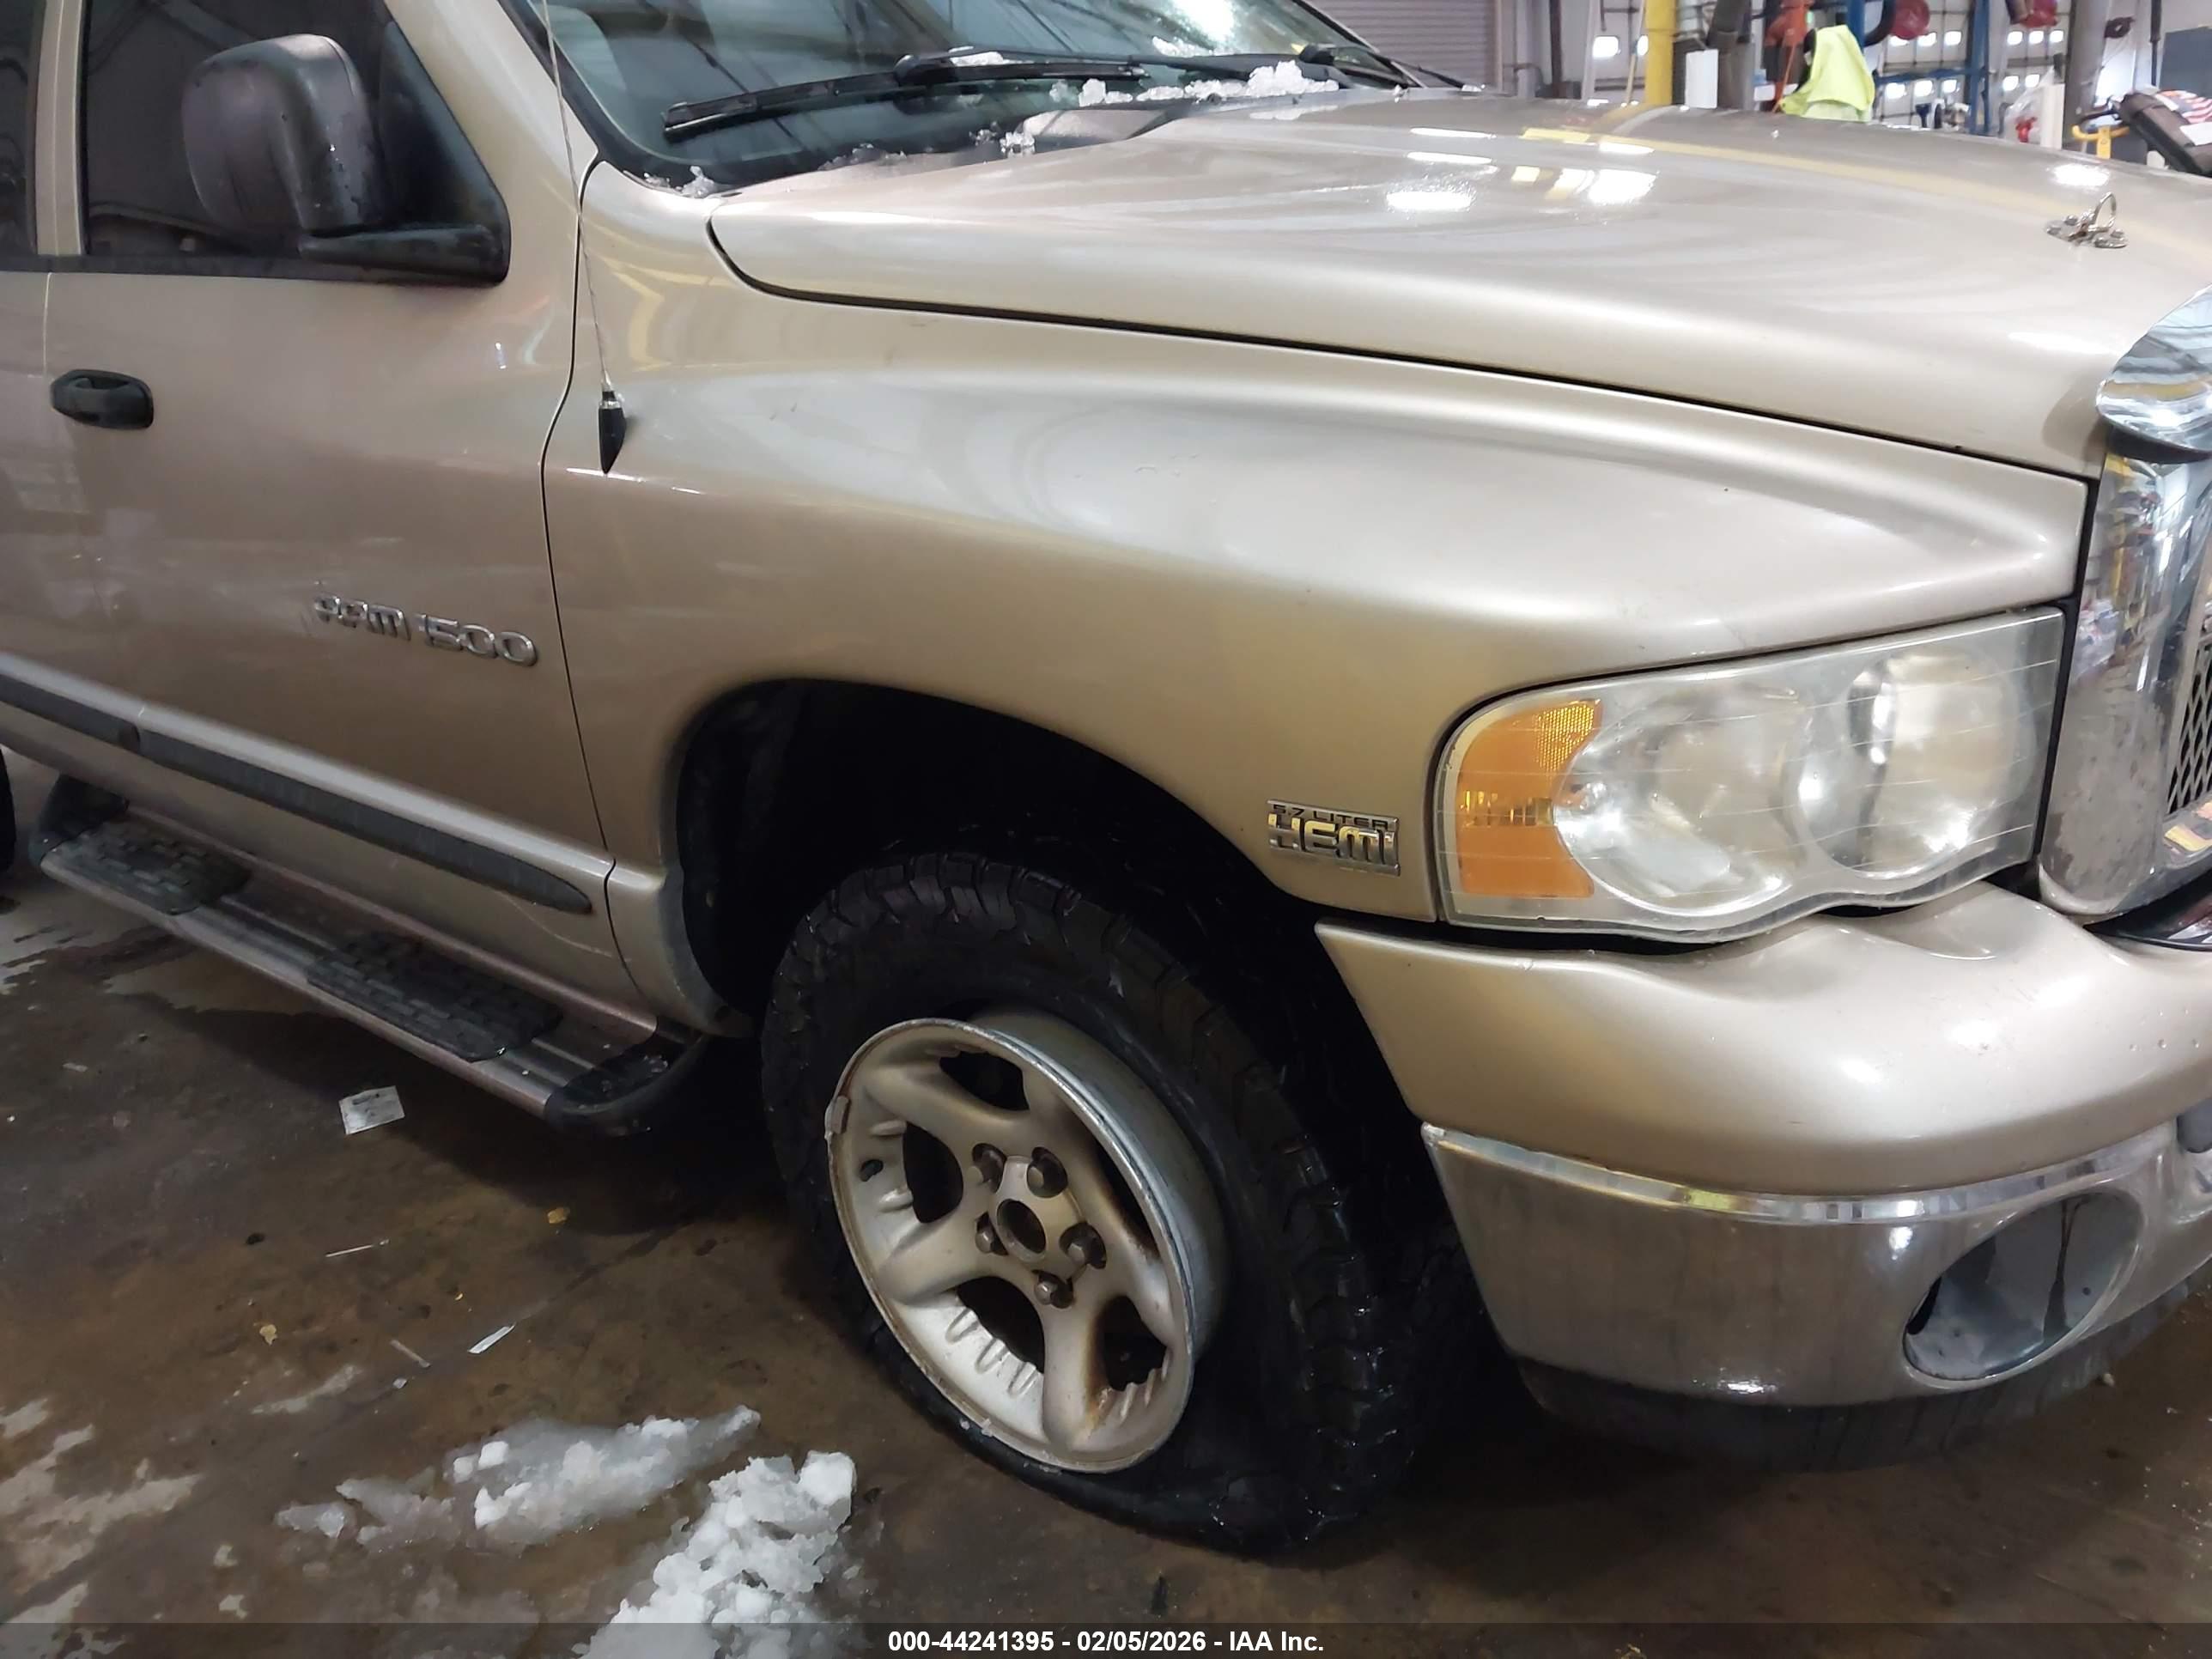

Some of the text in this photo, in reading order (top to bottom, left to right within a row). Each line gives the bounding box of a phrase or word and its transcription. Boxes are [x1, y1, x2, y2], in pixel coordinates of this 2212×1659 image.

[416, 612, 538, 666] 1500
[1267, 812, 1395, 866] HEMI
[1313, 810, 1389, 831] LITER
